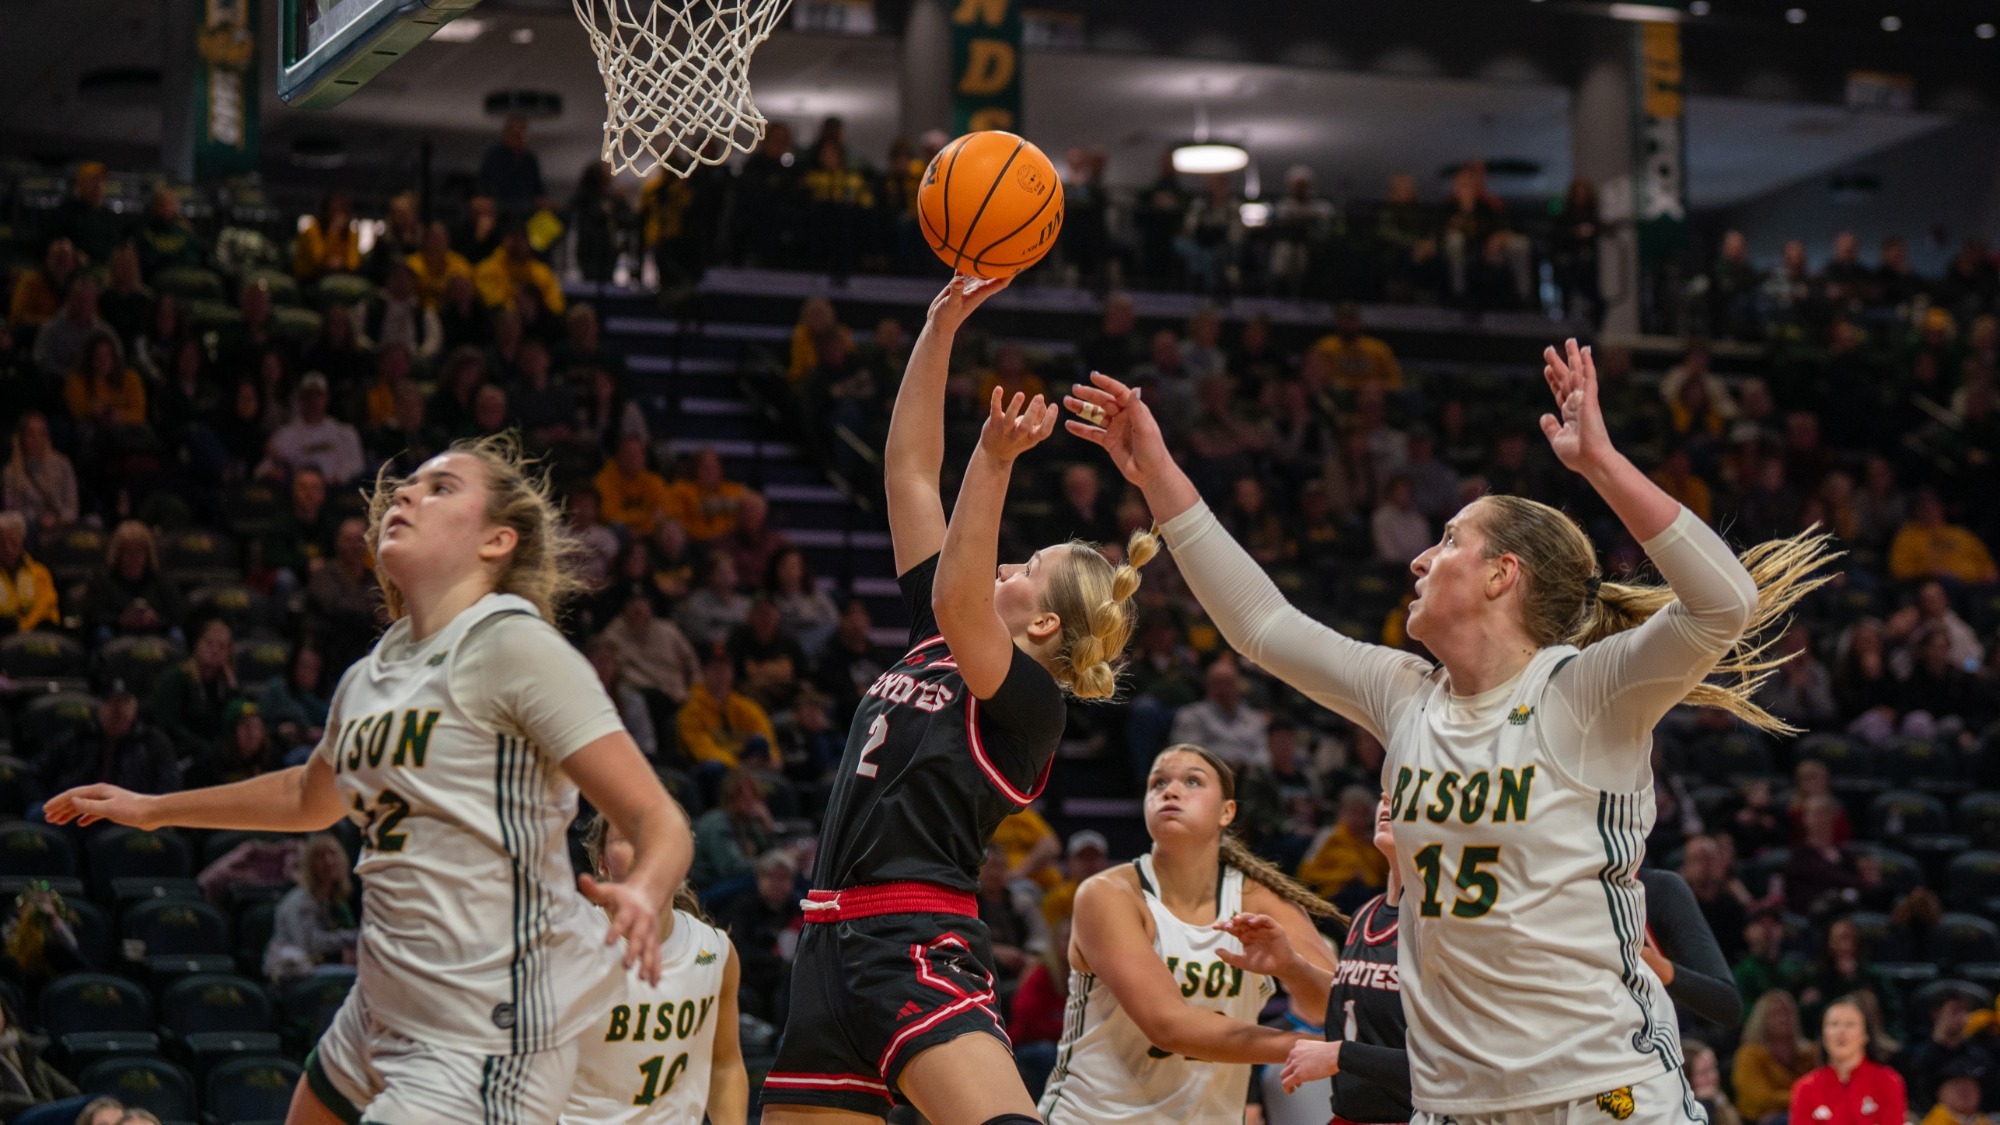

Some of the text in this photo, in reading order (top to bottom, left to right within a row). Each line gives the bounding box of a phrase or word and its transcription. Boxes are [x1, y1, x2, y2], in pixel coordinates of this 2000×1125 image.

[866, 671, 954, 713] OYOTES
[333, 708, 442, 774] ISON
[856, 713, 889, 779] 2
[1391, 764, 1536, 824] BISON
[1413, 843, 1500, 919] 15
[1166, 956, 1243, 998] SON
[1330, 959, 1399, 991] OYOTES
[1343, 999, 1358, 1042] 1
